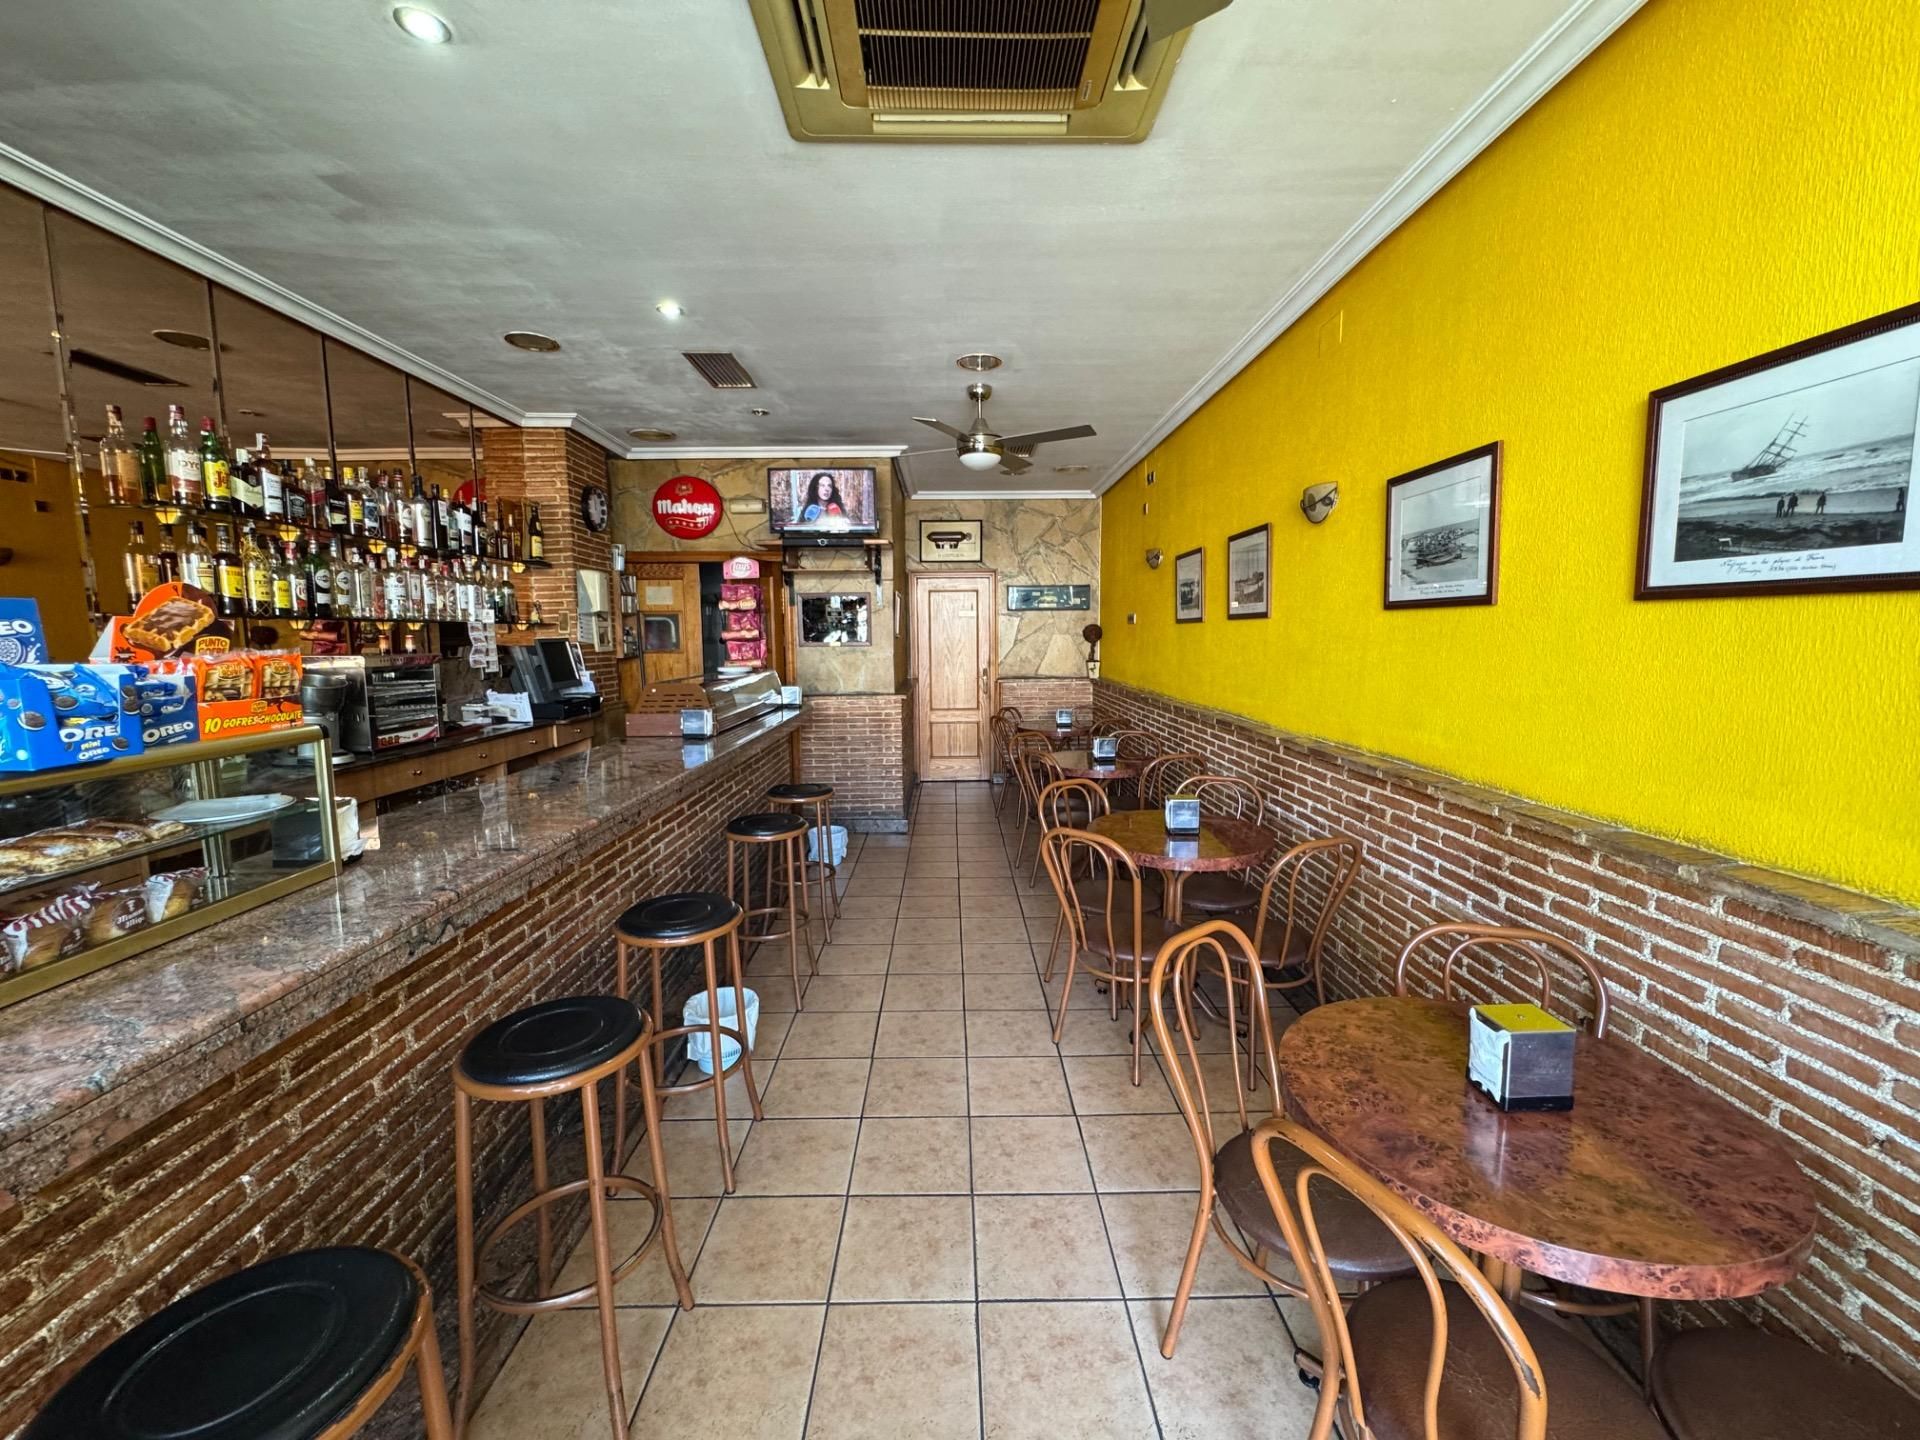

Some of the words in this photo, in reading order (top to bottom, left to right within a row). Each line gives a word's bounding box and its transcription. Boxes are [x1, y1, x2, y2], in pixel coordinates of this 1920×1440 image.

[657, 498, 716, 515] Mahou
[0, 619, 33, 636] EO
[198, 639, 228, 648] PUNTO
[204, 717, 221, 734] 10
[223, 715, 258, 729] GOFRES
[259, 710, 304, 724] CHOCOLATE
[143, 721, 194, 743] OREO
[79, 747, 109, 760] OREO
